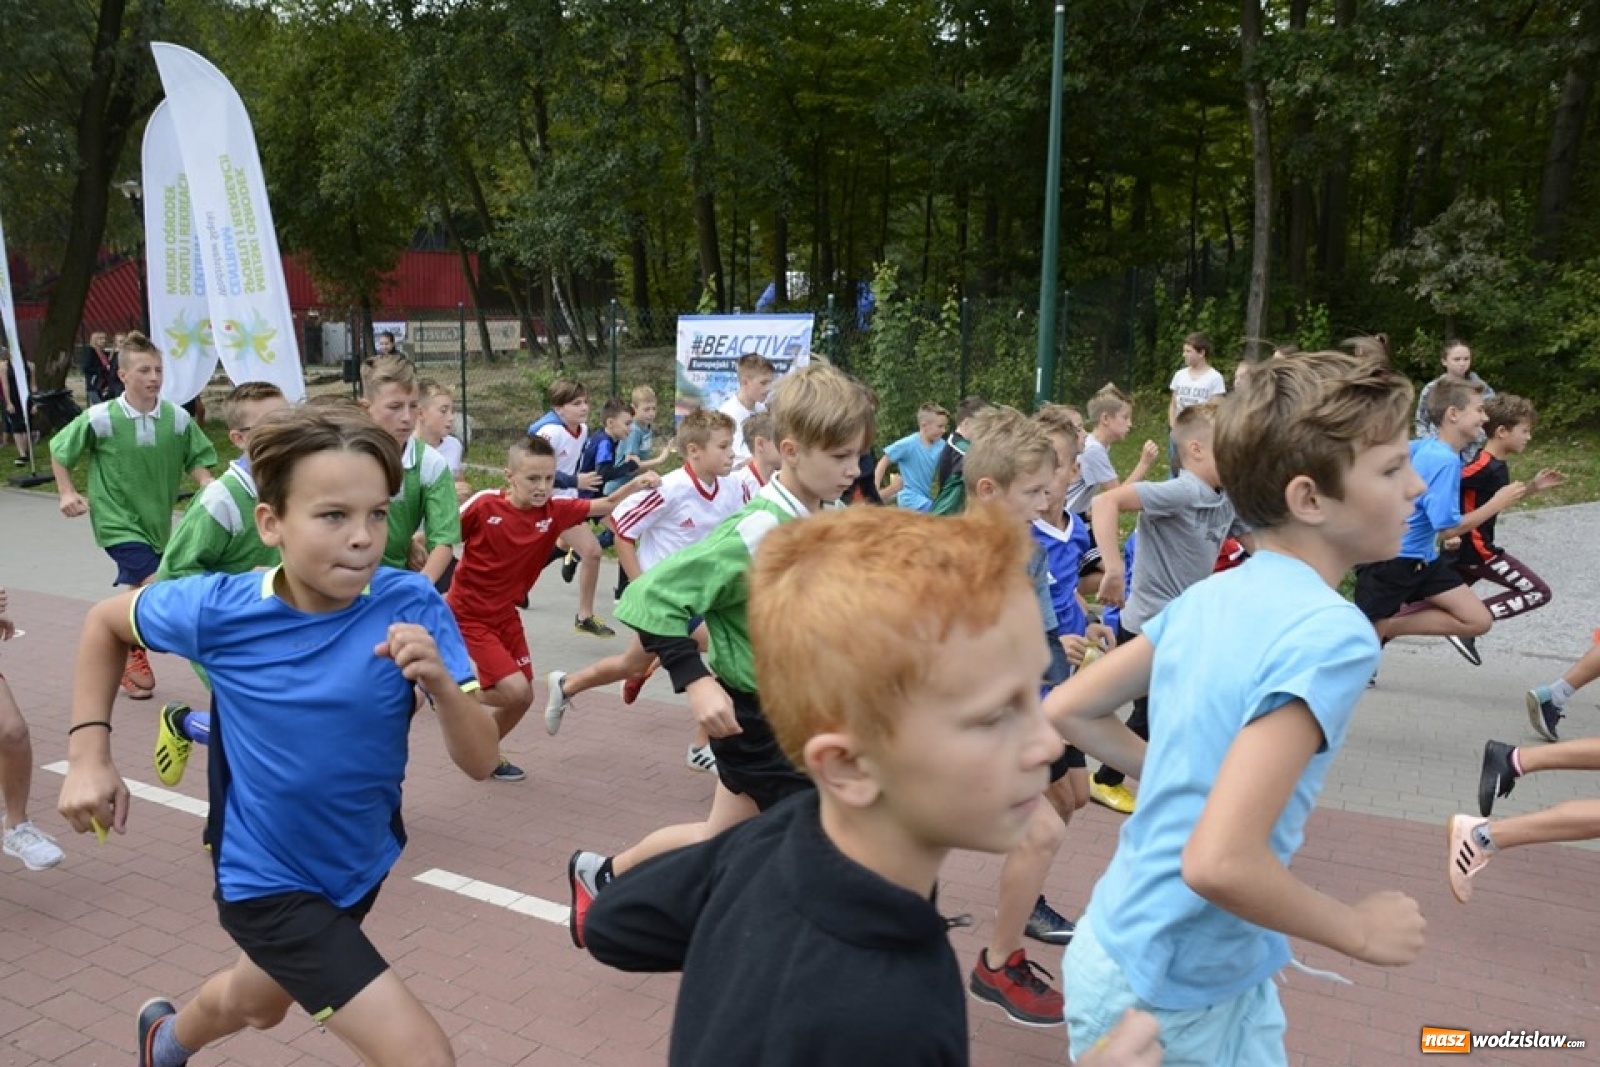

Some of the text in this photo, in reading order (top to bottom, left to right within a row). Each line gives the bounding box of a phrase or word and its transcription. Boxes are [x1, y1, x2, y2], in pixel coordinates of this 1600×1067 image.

[178, 173, 191, 236] REKREACJI
[163, 185, 177, 295] MIEJSKI OŚRODEK
[179, 246, 191, 295] SPORTU
[691, 334, 802, 356] #BEACTIVE
